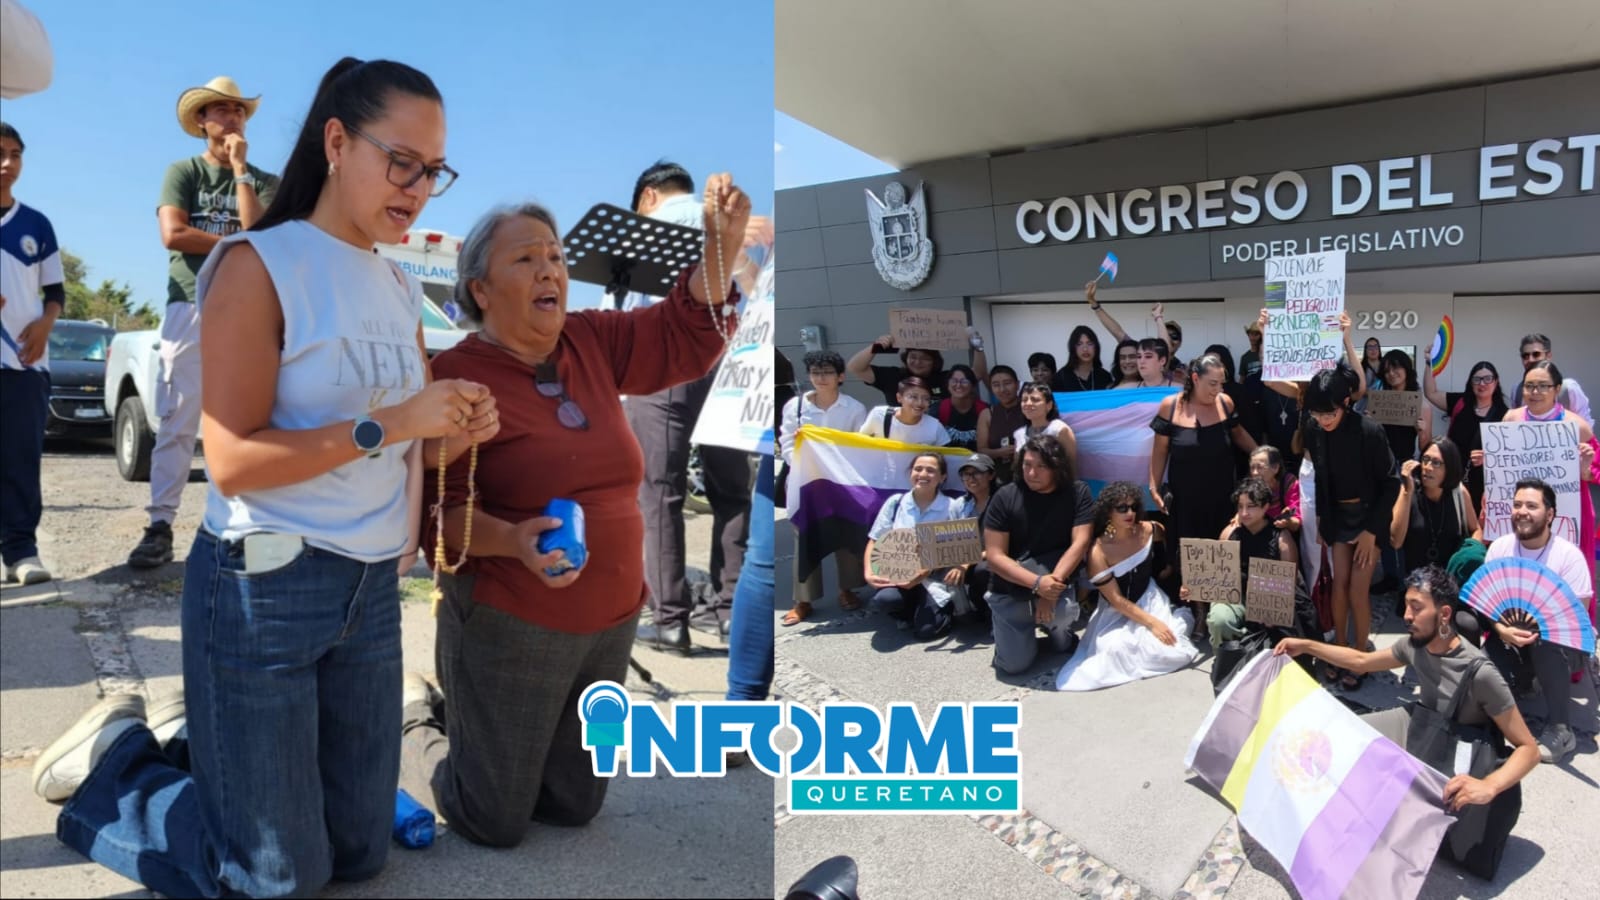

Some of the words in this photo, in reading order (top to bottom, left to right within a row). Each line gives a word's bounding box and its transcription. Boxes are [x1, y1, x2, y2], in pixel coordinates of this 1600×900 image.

[1016, 170, 1308, 245] CONGRESO
[1331, 154, 1454, 216] DEL
[1222, 239, 1298, 263] PODER
[397, 261, 460, 281] BULANC
[1357, 310, 1419, 330] 2920
[335, 336, 421, 391] NEE
[1485, 424, 1516, 453] SE
[1518, 422, 1579, 451] DICEN
[1484, 450, 1555, 468] DEFENSORES
[1560, 449, 1576, 461] de
[1484, 469, 1497, 486] LA
[1486, 486, 1495, 501] Y
